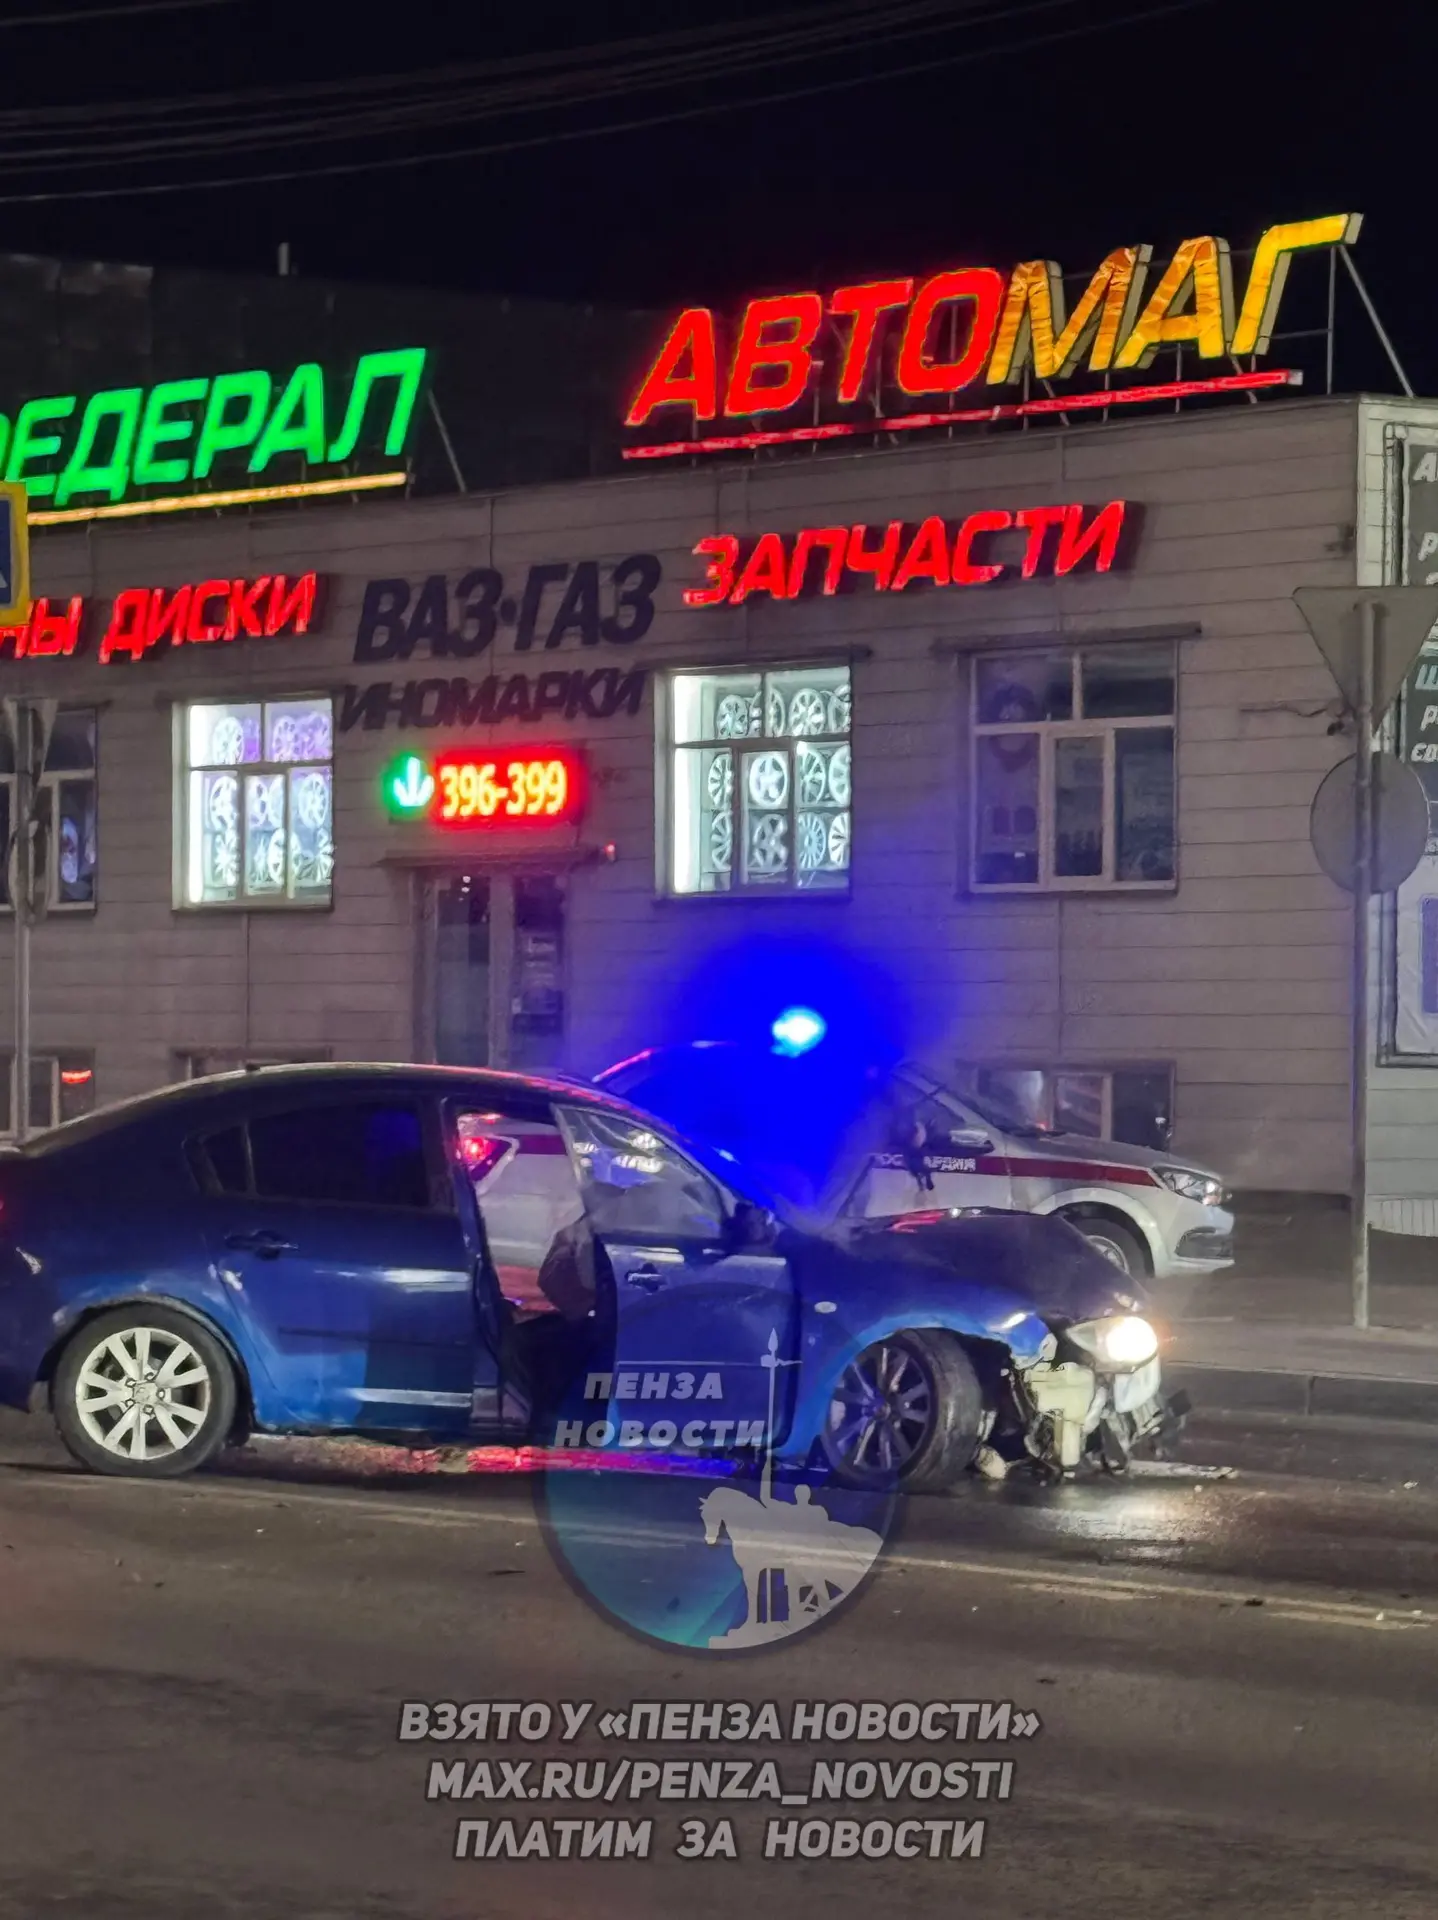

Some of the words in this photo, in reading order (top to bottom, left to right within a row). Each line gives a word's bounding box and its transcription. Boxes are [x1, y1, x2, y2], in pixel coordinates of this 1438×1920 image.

[624, 213, 1363, 428] АВТОМАГ
[0, 348, 426, 506] ЕДЕРАЛ
[684, 500, 1127, 605] ЗАПЧАСТИ
[98, 572, 318, 665] ДИСКИ
[337, 667, 652, 732] ИНОМАРКИ
[440, 758, 568, 819] 396-399
